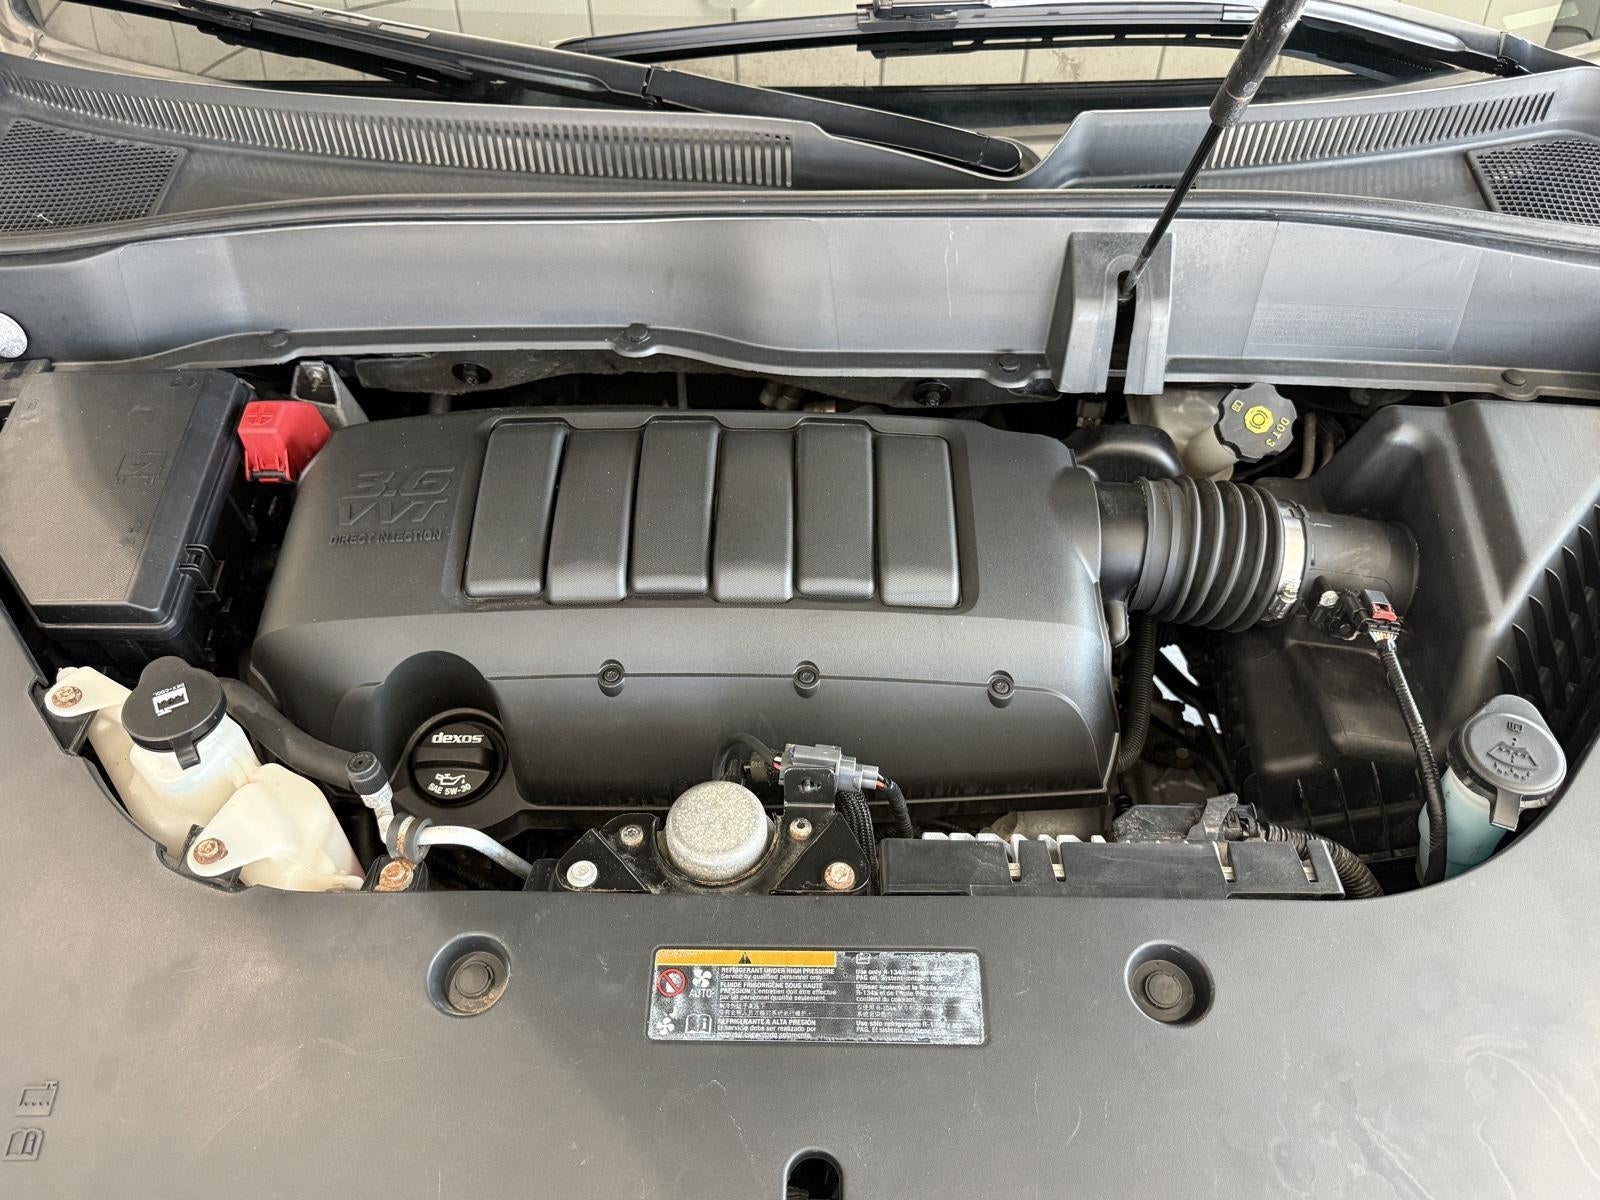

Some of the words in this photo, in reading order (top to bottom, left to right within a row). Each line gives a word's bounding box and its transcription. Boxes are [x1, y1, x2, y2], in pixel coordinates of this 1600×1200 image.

[1272, 416, 1290, 440] DOT
[1265, 438, 1276, 447] 3
[341, 467, 455, 499] 3.6
[338, 498, 448, 526] VVT
[328, 532, 374, 545] DIRECT
[376, 529, 443, 545] INJECTION
[431, 731, 484, 744] dexos
[427, 783, 444, 795] SAE
[444, 783, 472, 796] 5W-30
[688, 989, 712, 998] AUTO
[788, 1018, 817, 1026] PRESIÓN
